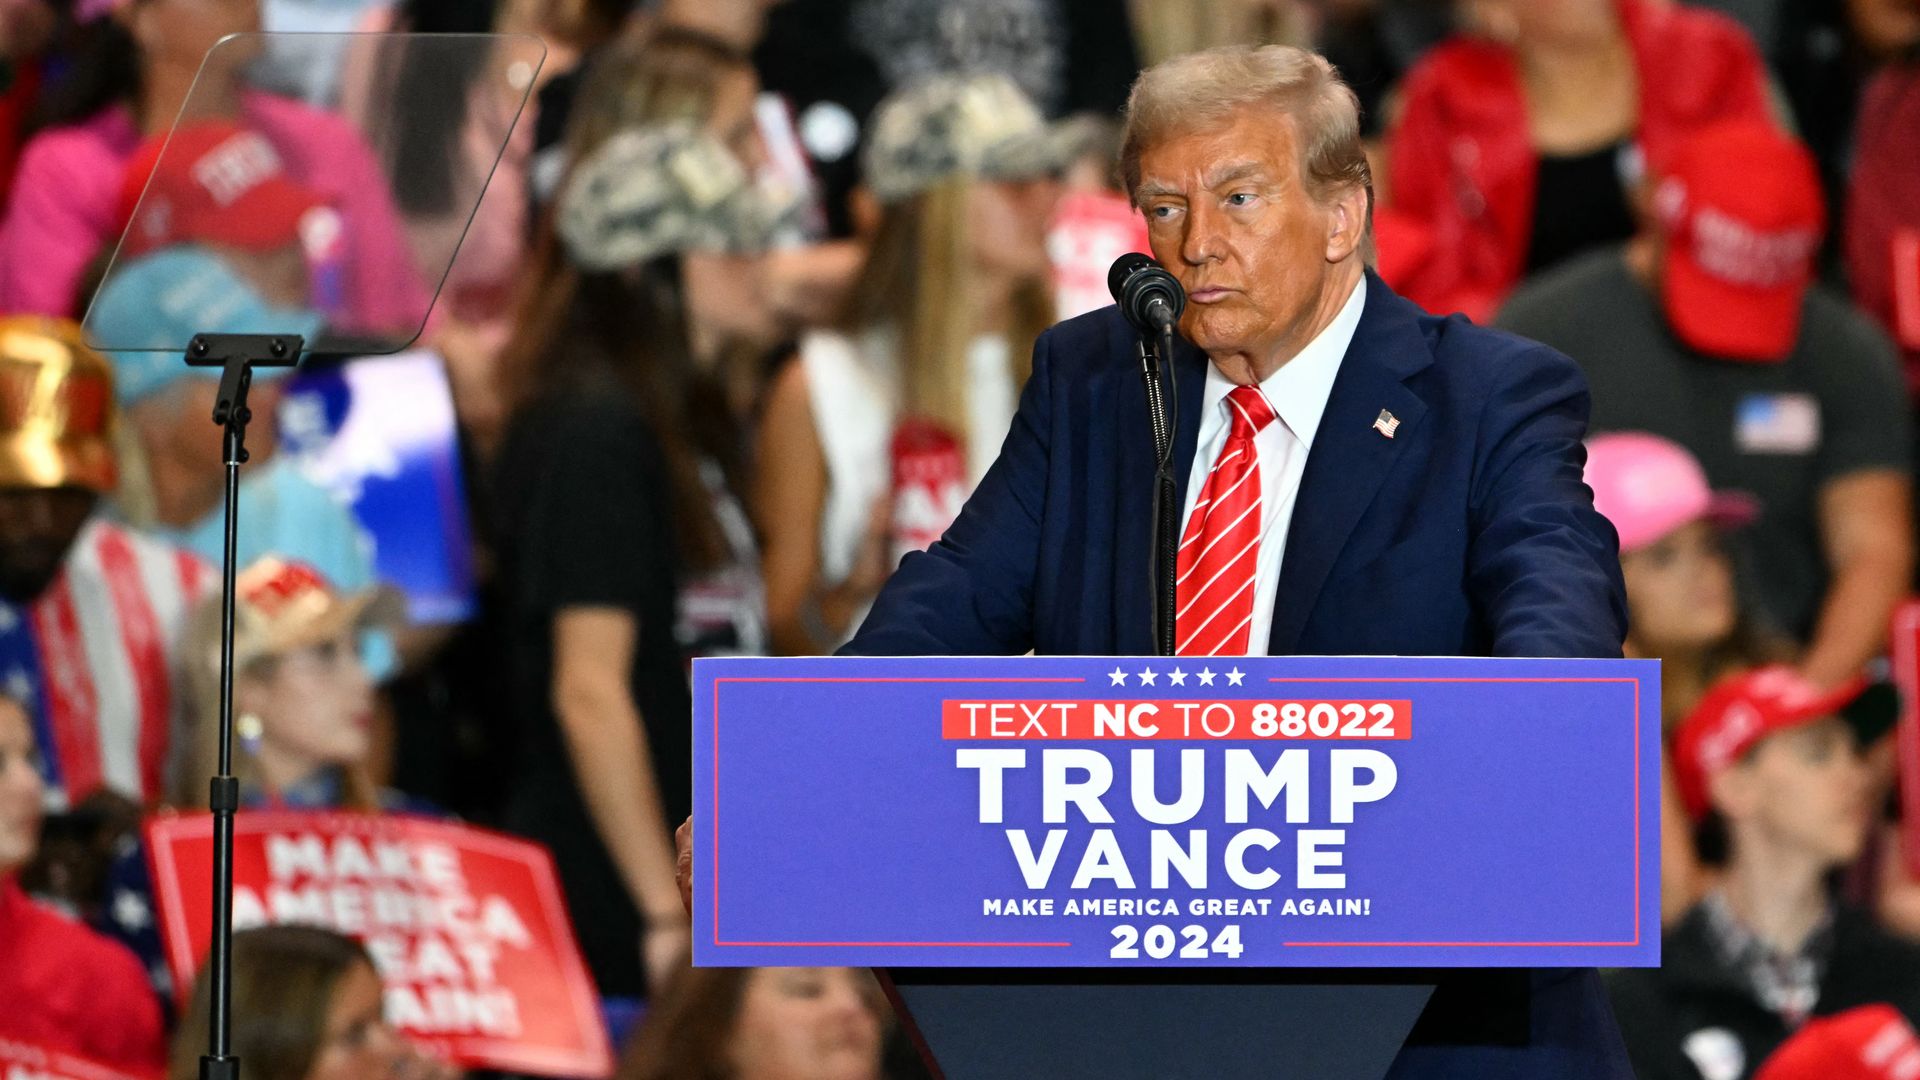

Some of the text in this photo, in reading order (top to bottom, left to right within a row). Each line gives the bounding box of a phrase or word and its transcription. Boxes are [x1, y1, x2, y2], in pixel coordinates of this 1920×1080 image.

[959, 702, 1395, 738] TEXT NC TO 88022
[956, 748, 1398, 825] TRUMP
[264, 832, 466, 886] MAKE
[1005, 828, 1346, 890] VANCE
[983, 898, 1371, 916] MAKE AMERICA GREAT AGAIN!
[368, 934, 499, 986] EAT
[1110, 924, 1244, 960] 2024
